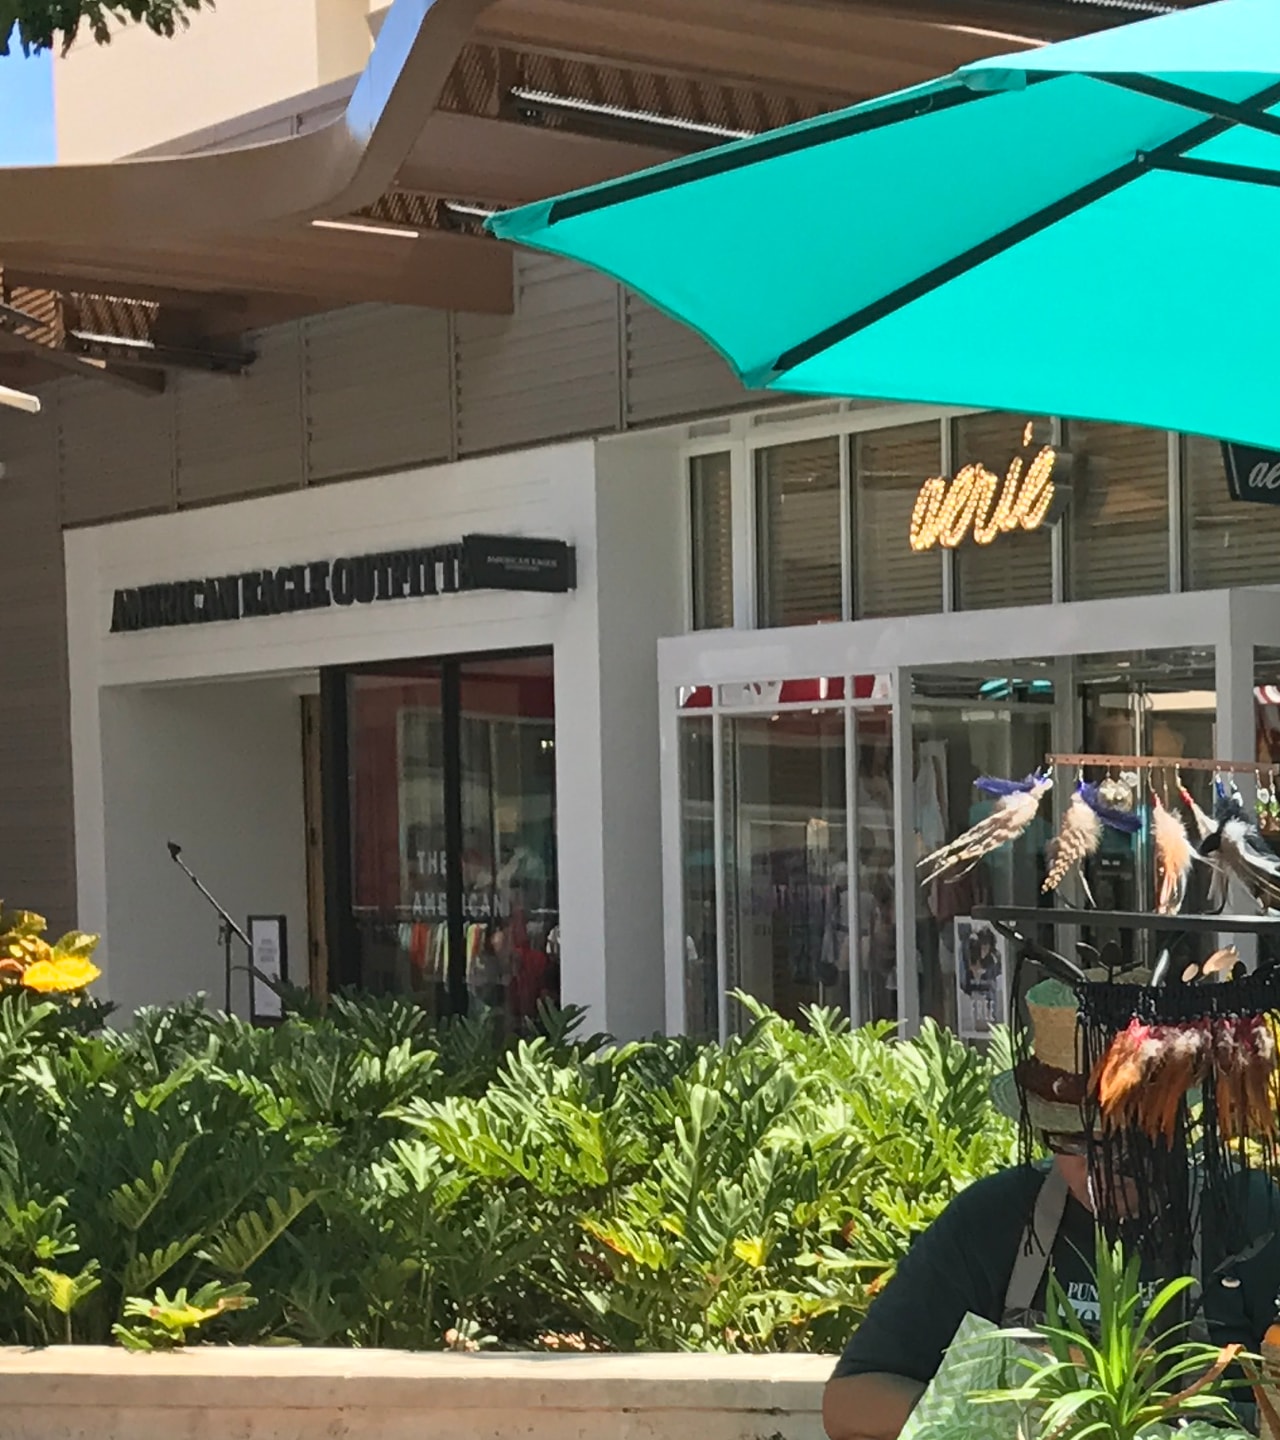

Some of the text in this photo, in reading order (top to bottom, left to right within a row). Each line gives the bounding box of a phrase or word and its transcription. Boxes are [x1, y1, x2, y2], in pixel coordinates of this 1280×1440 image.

[910, 420, 1056, 551] aerie
[110, 572, 239, 632] AMERICAN
[241, 559, 330, 619] EAGLE
